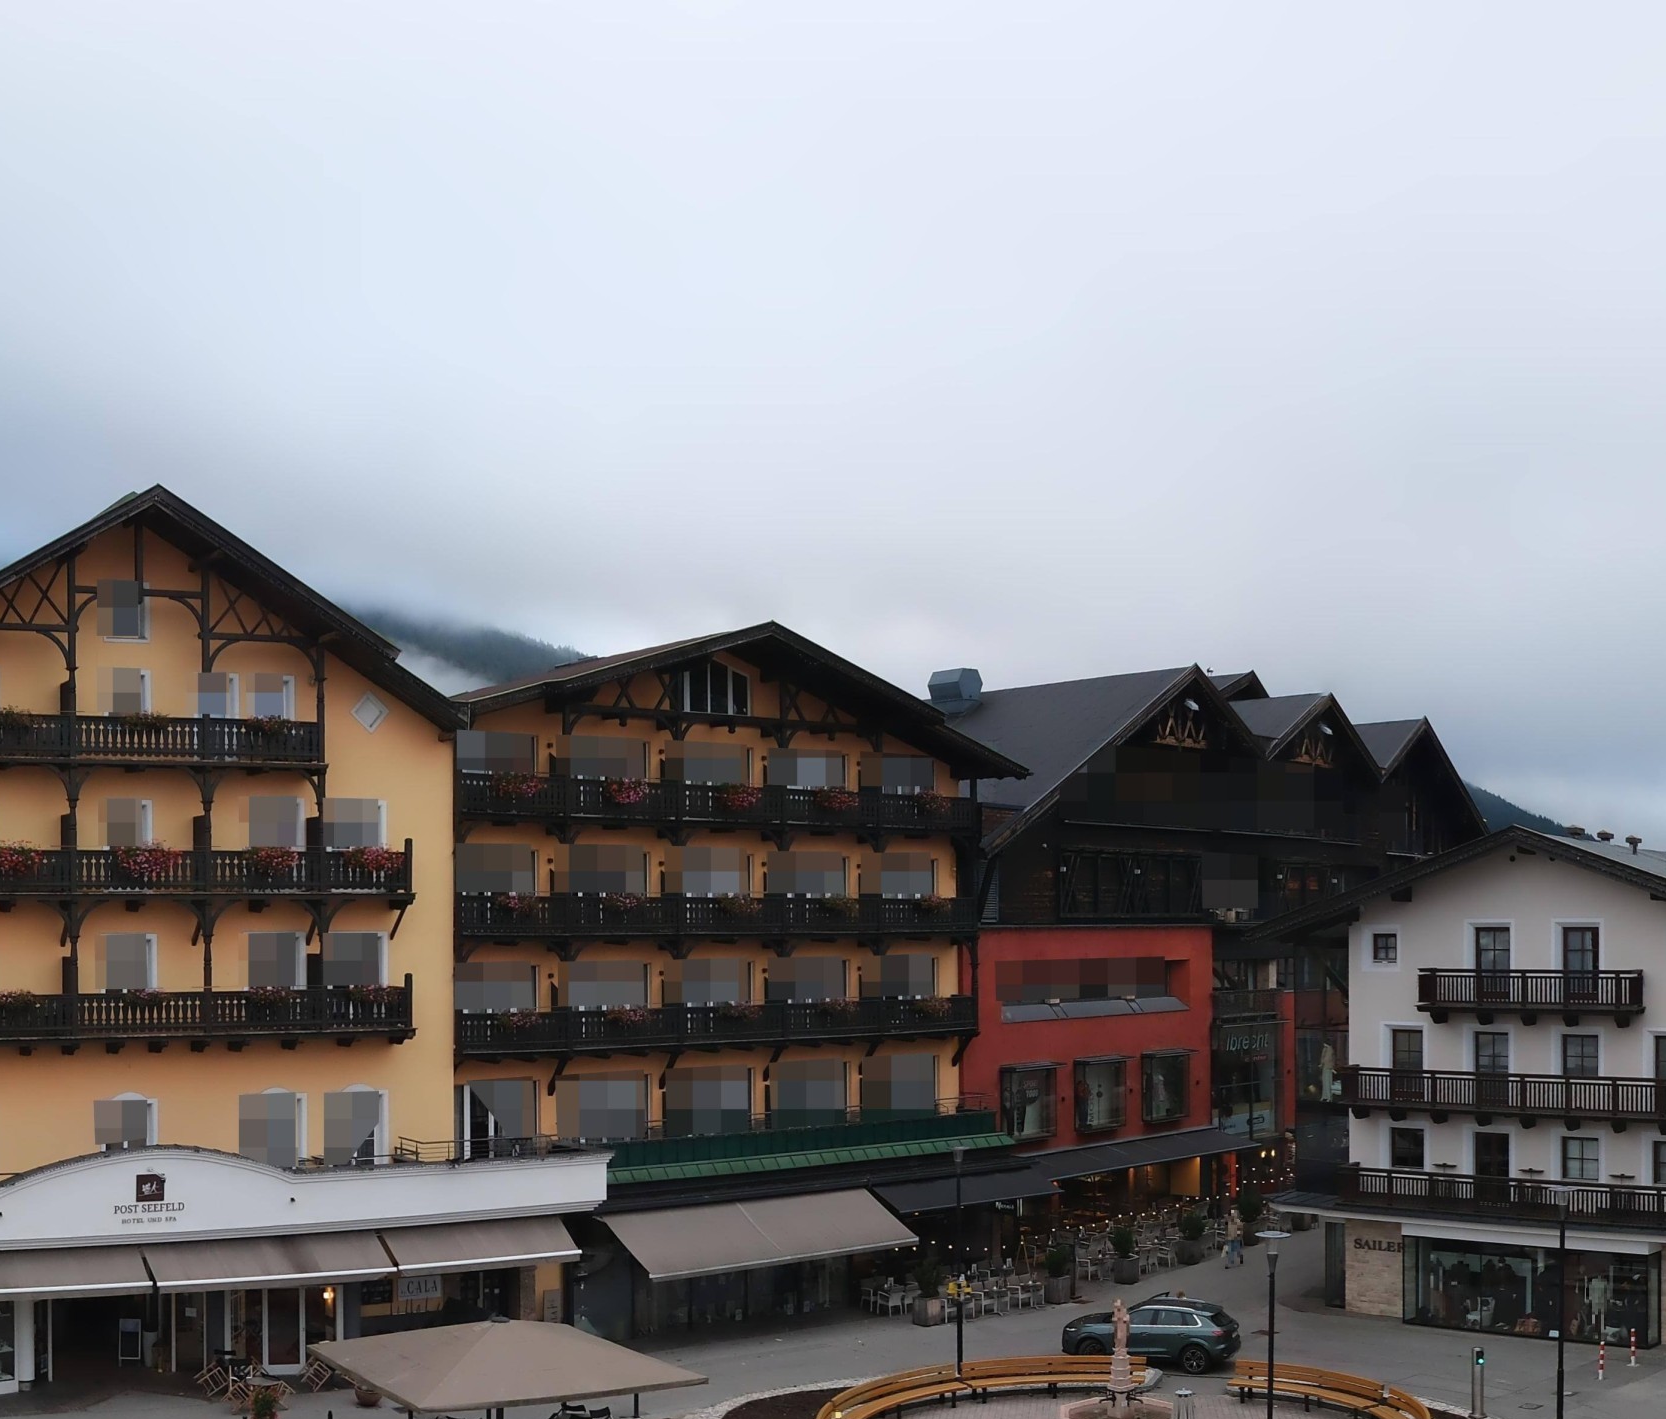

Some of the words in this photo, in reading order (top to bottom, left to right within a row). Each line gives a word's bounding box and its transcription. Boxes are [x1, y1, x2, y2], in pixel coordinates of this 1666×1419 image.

[114, 1204, 139, 1214] POST
[141, 1202, 185, 1213] SEEFELD
[122, 1217, 145, 1225] HOTEL
[407, 1279, 438, 1295] CALA
